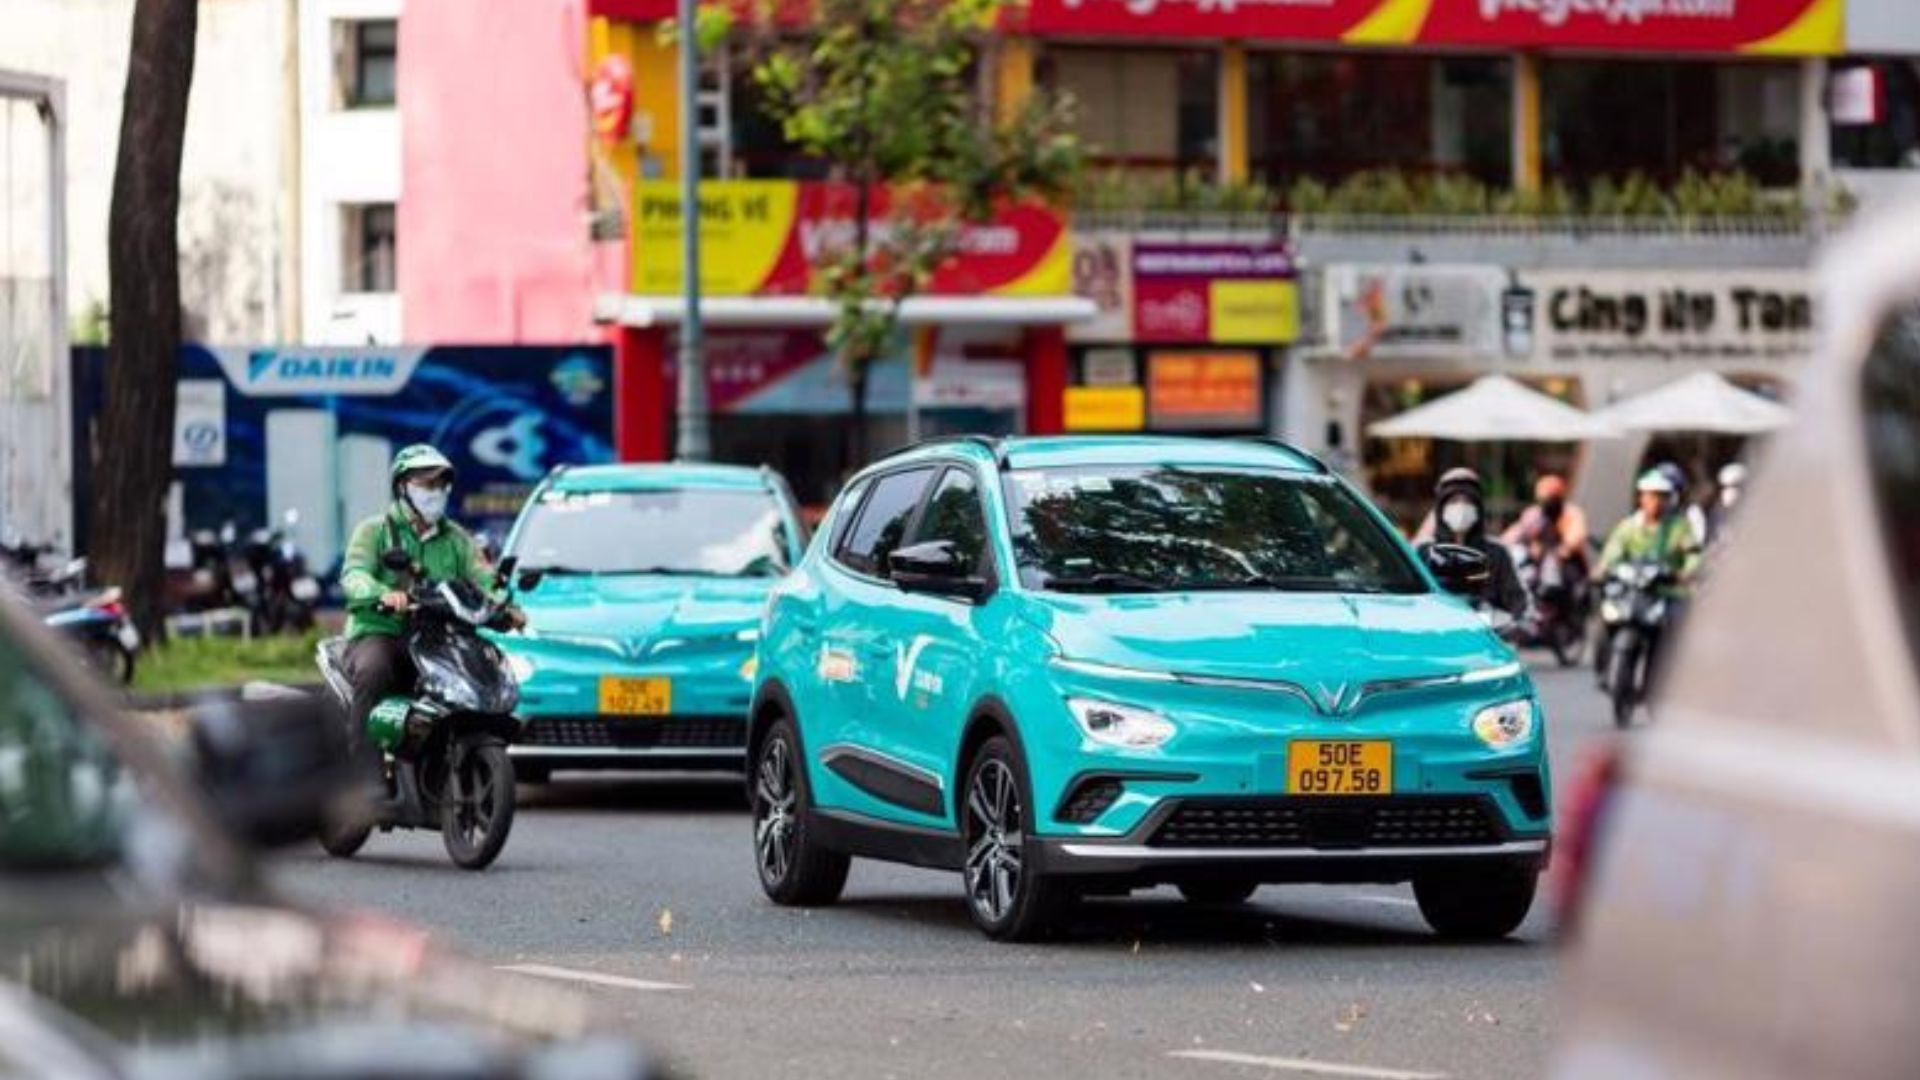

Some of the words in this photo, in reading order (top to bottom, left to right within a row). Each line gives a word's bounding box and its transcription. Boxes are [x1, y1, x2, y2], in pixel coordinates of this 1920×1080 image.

[641, 197, 733, 221] PHNG
[279, 356, 397, 378] DAIKIN
[1318, 743, 1363, 766] 50E
[1300, 769, 1381, 792] 097.58
